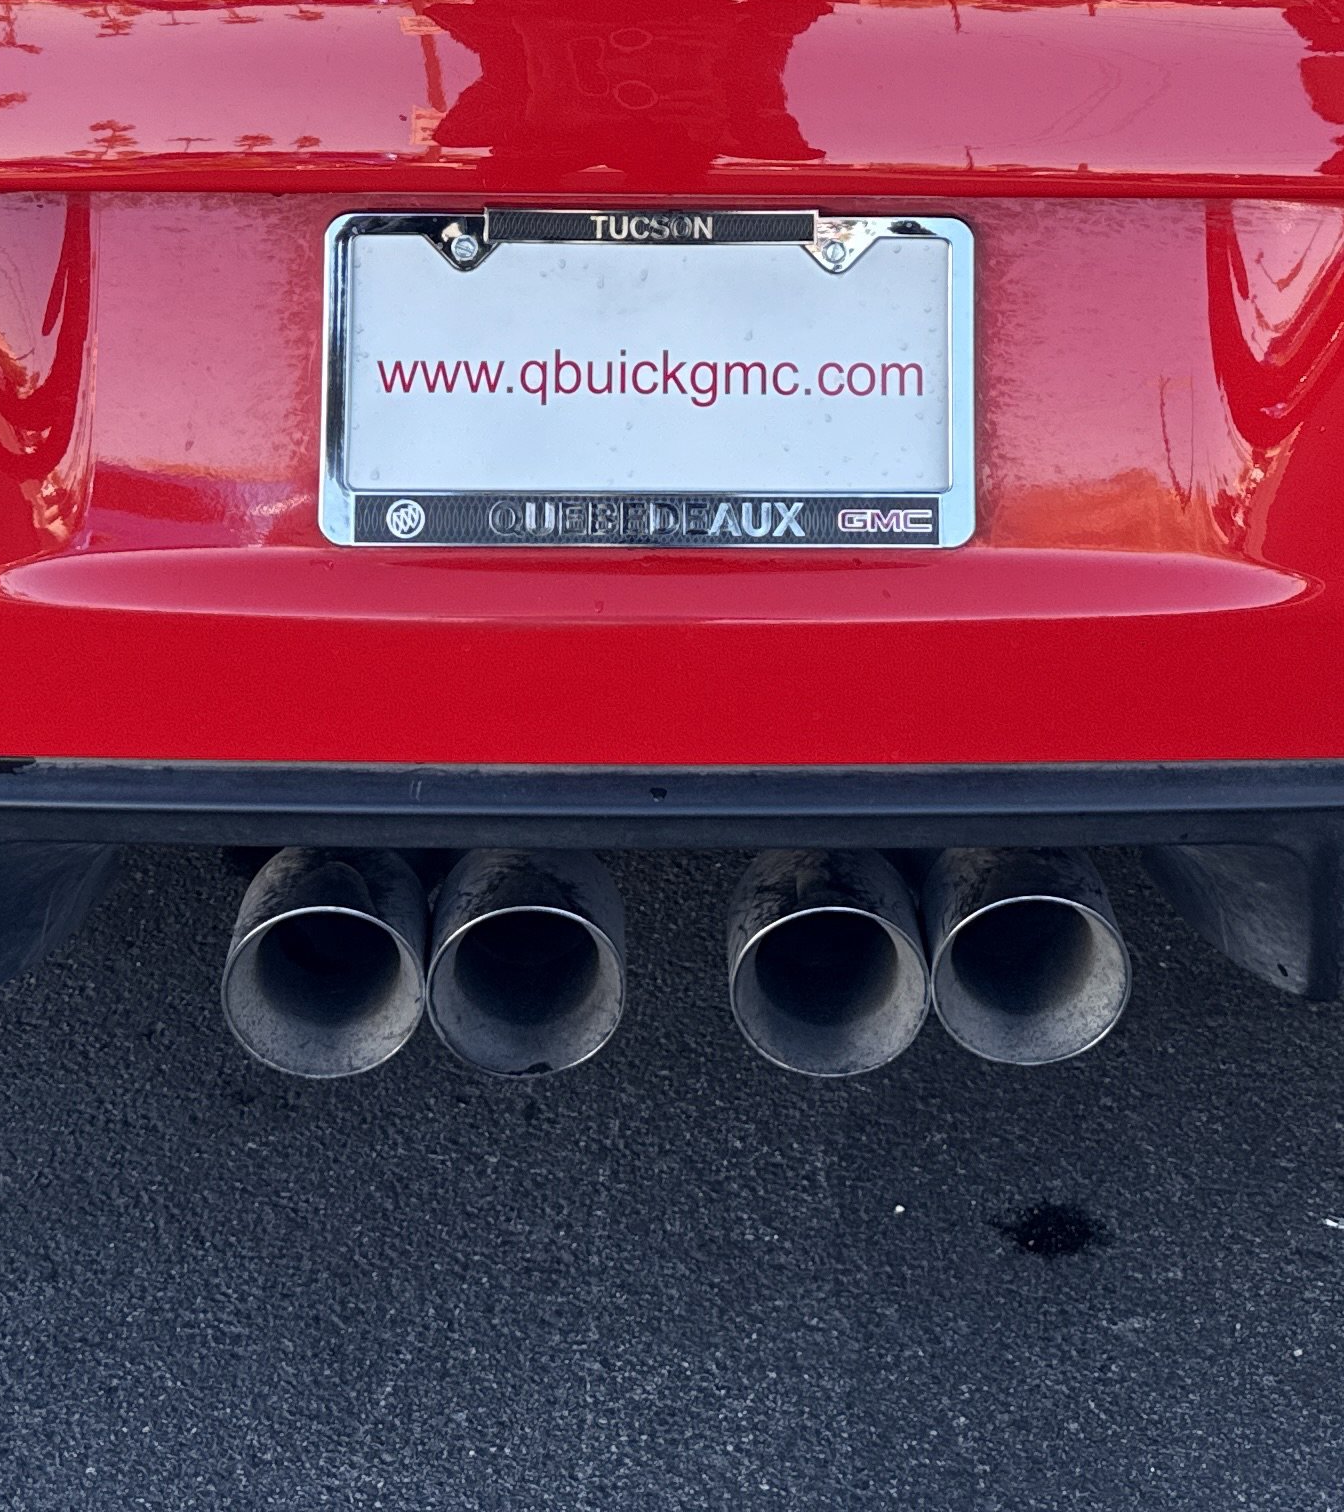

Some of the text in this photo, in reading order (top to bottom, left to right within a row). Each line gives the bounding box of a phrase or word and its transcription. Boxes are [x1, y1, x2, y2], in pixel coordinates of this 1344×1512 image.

[590, 215, 713, 240] TUCSON
[377, 350, 924, 407] www.qbuickgmc.com
[488, 501, 933, 538] QUEBEDEAUX GMC
